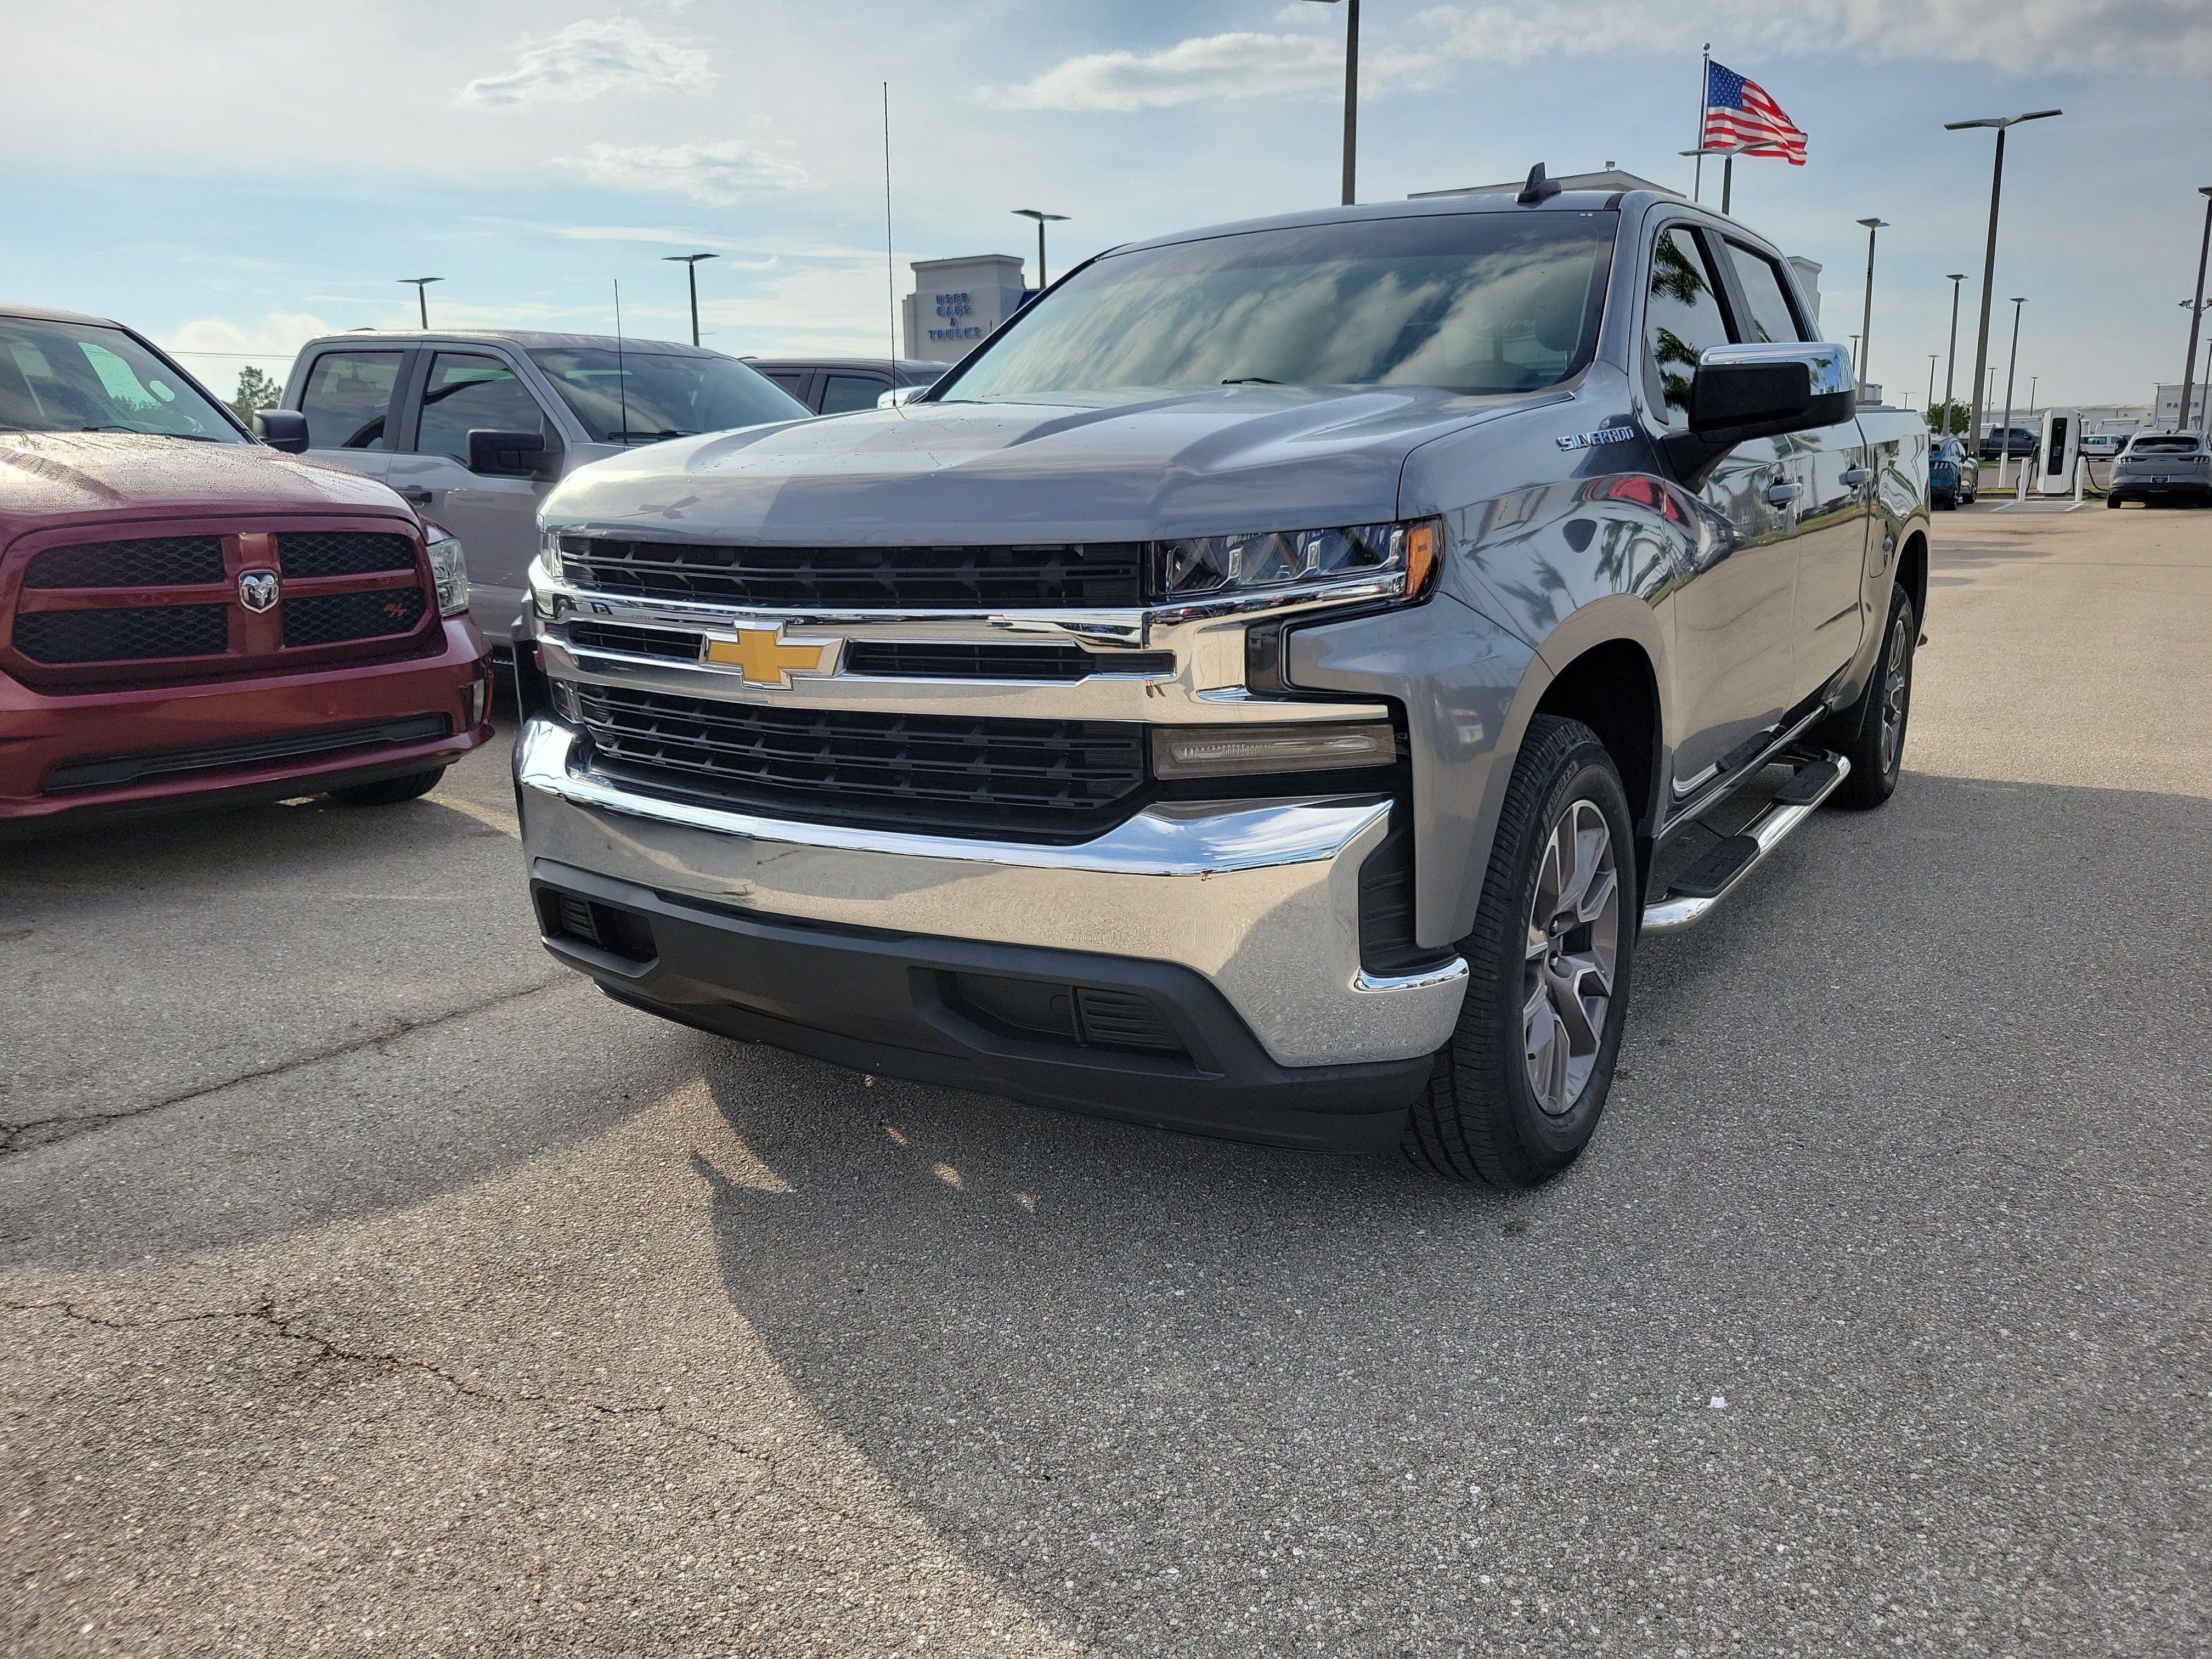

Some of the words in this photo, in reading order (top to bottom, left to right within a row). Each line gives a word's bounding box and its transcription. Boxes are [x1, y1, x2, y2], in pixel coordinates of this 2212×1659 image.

[936, 293, 968, 304] USED
[936, 305, 969, 316] CARS
[950, 317, 956, 327] &
[928, 327, 980, 340] TRUCKS
